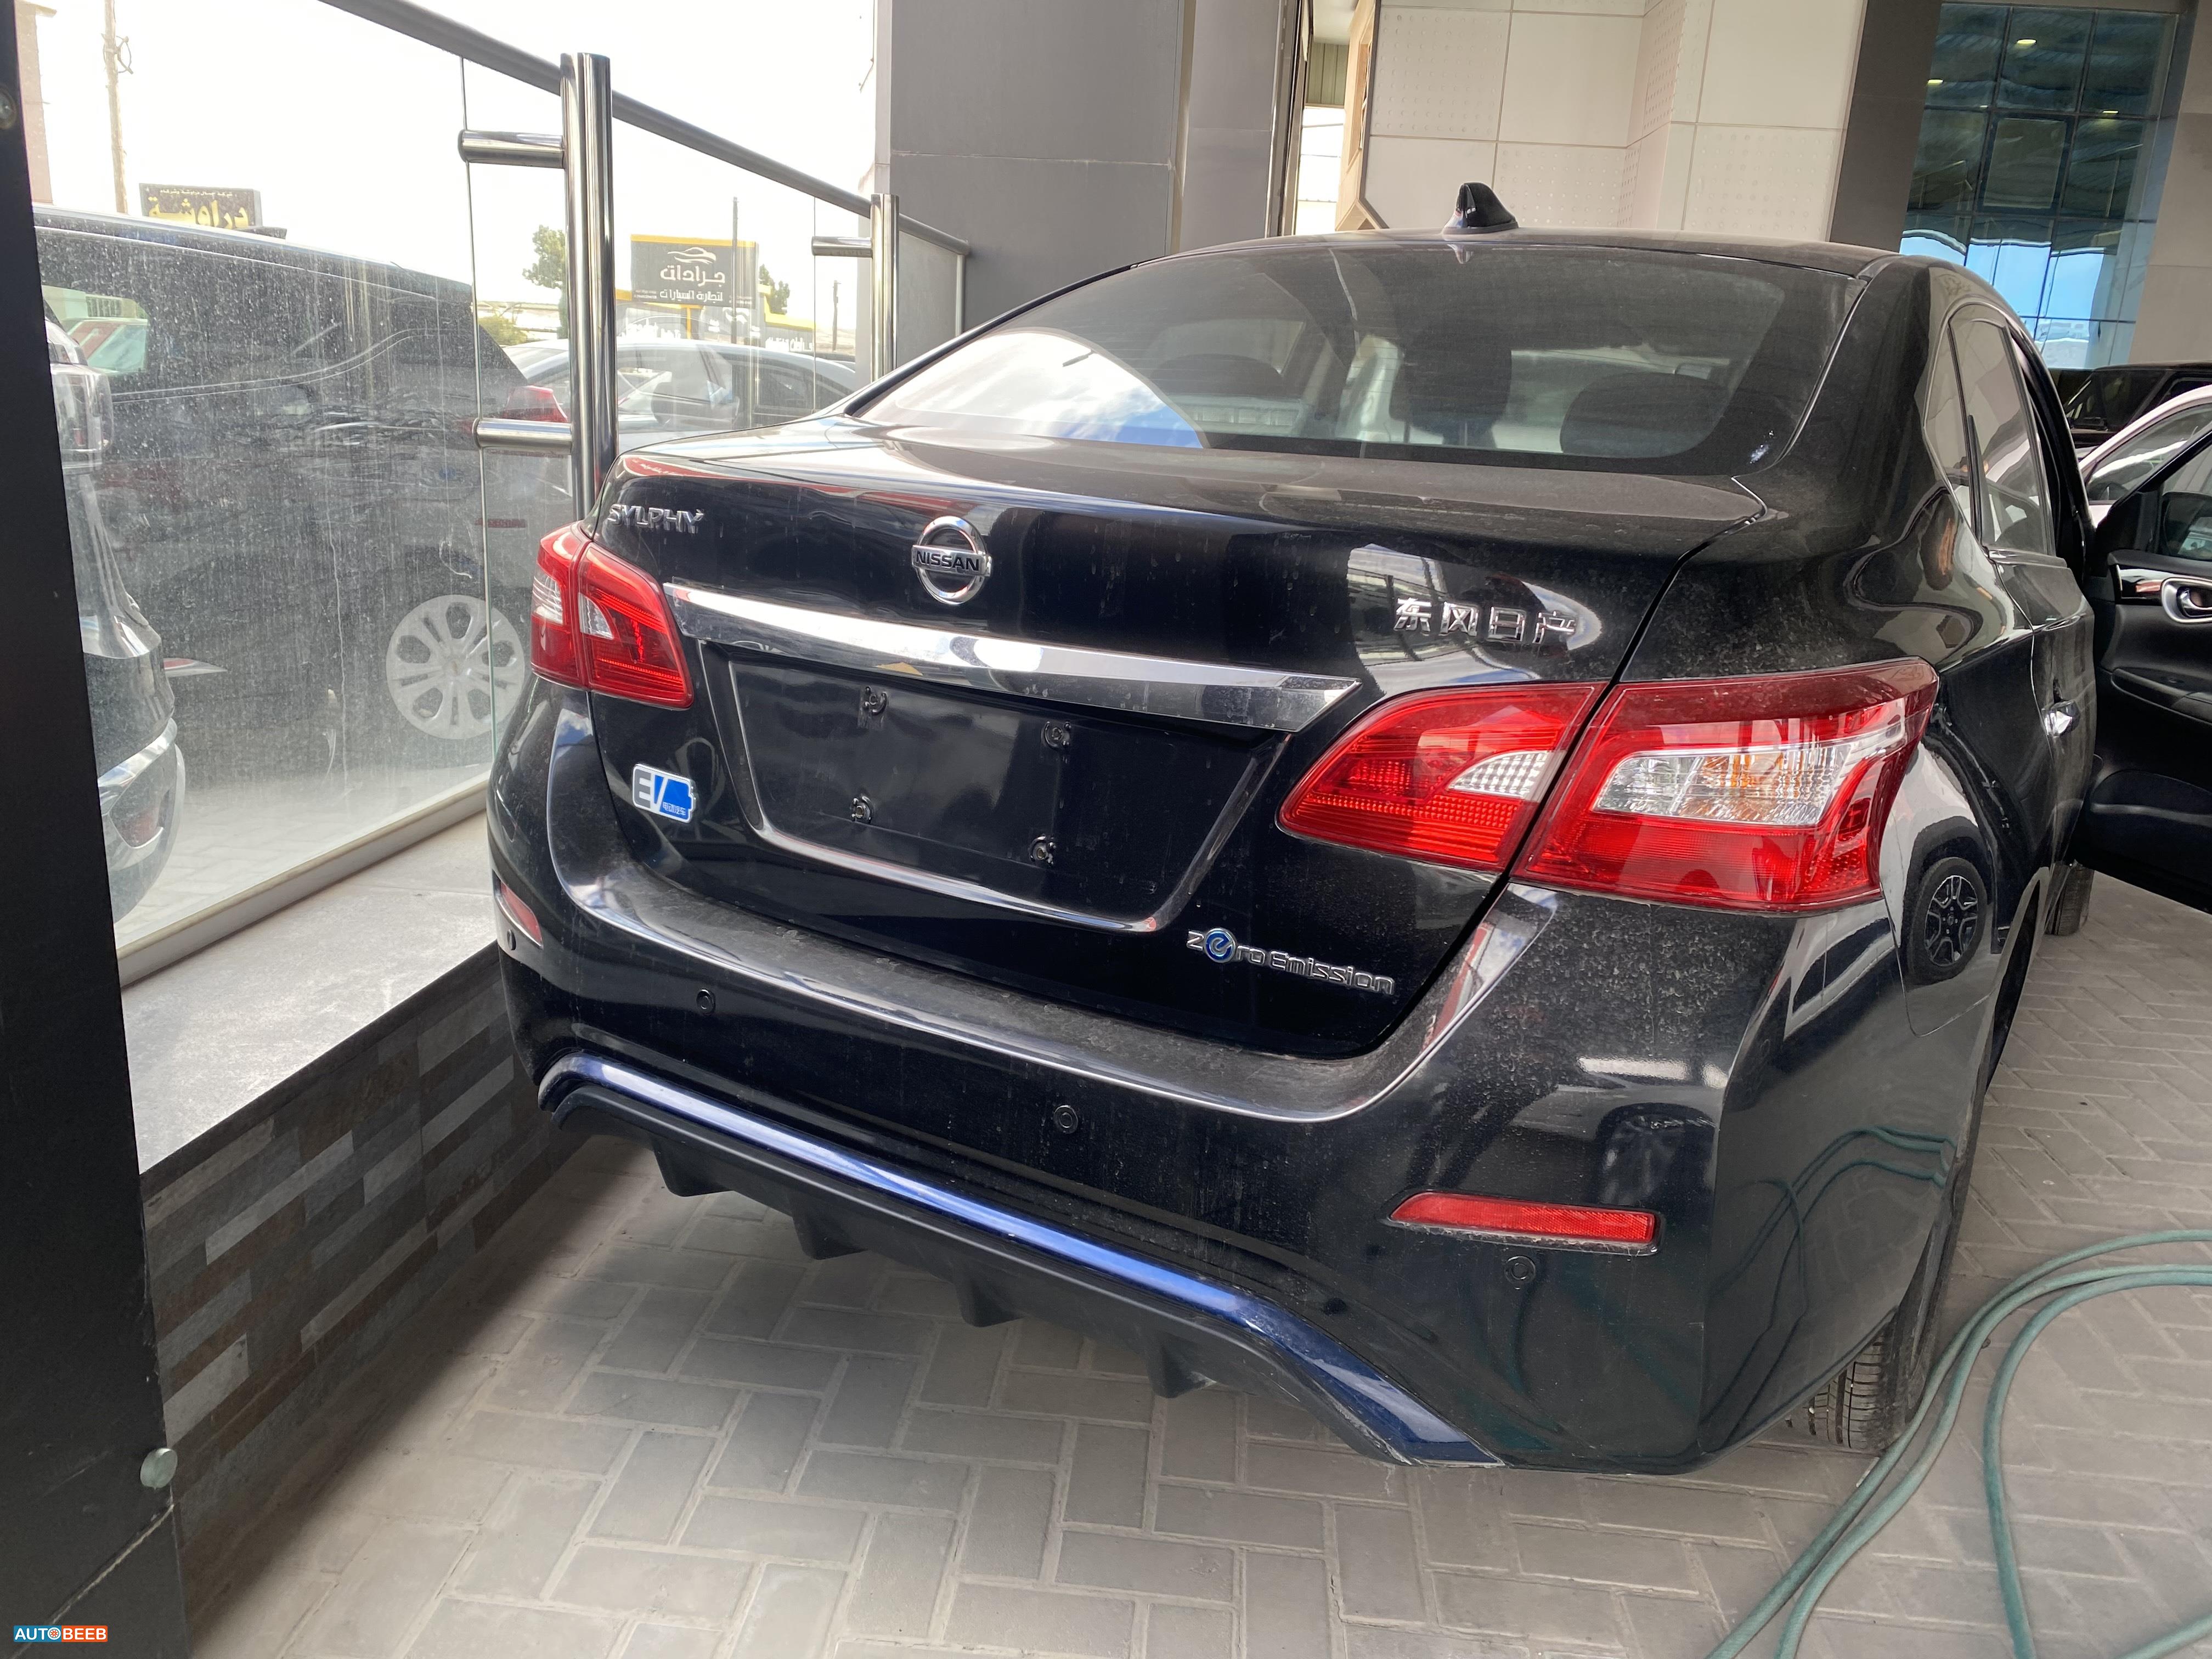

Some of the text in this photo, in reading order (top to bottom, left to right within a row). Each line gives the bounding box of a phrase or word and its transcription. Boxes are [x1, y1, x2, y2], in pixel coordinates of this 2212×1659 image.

[148, 196, 249, 229] دراوشة
[660, 264, 725, 287] جرادات
[659, 289, 695, 302] السيارات
[696, 291, 723, 303] لتجارة
[607, 504, 704, 534] SYLPHY
[916, 550, 980, 572] NISSAN
[1393, 597, 1577, 644] 东风日产
[634, 767, 668, 813] EV
